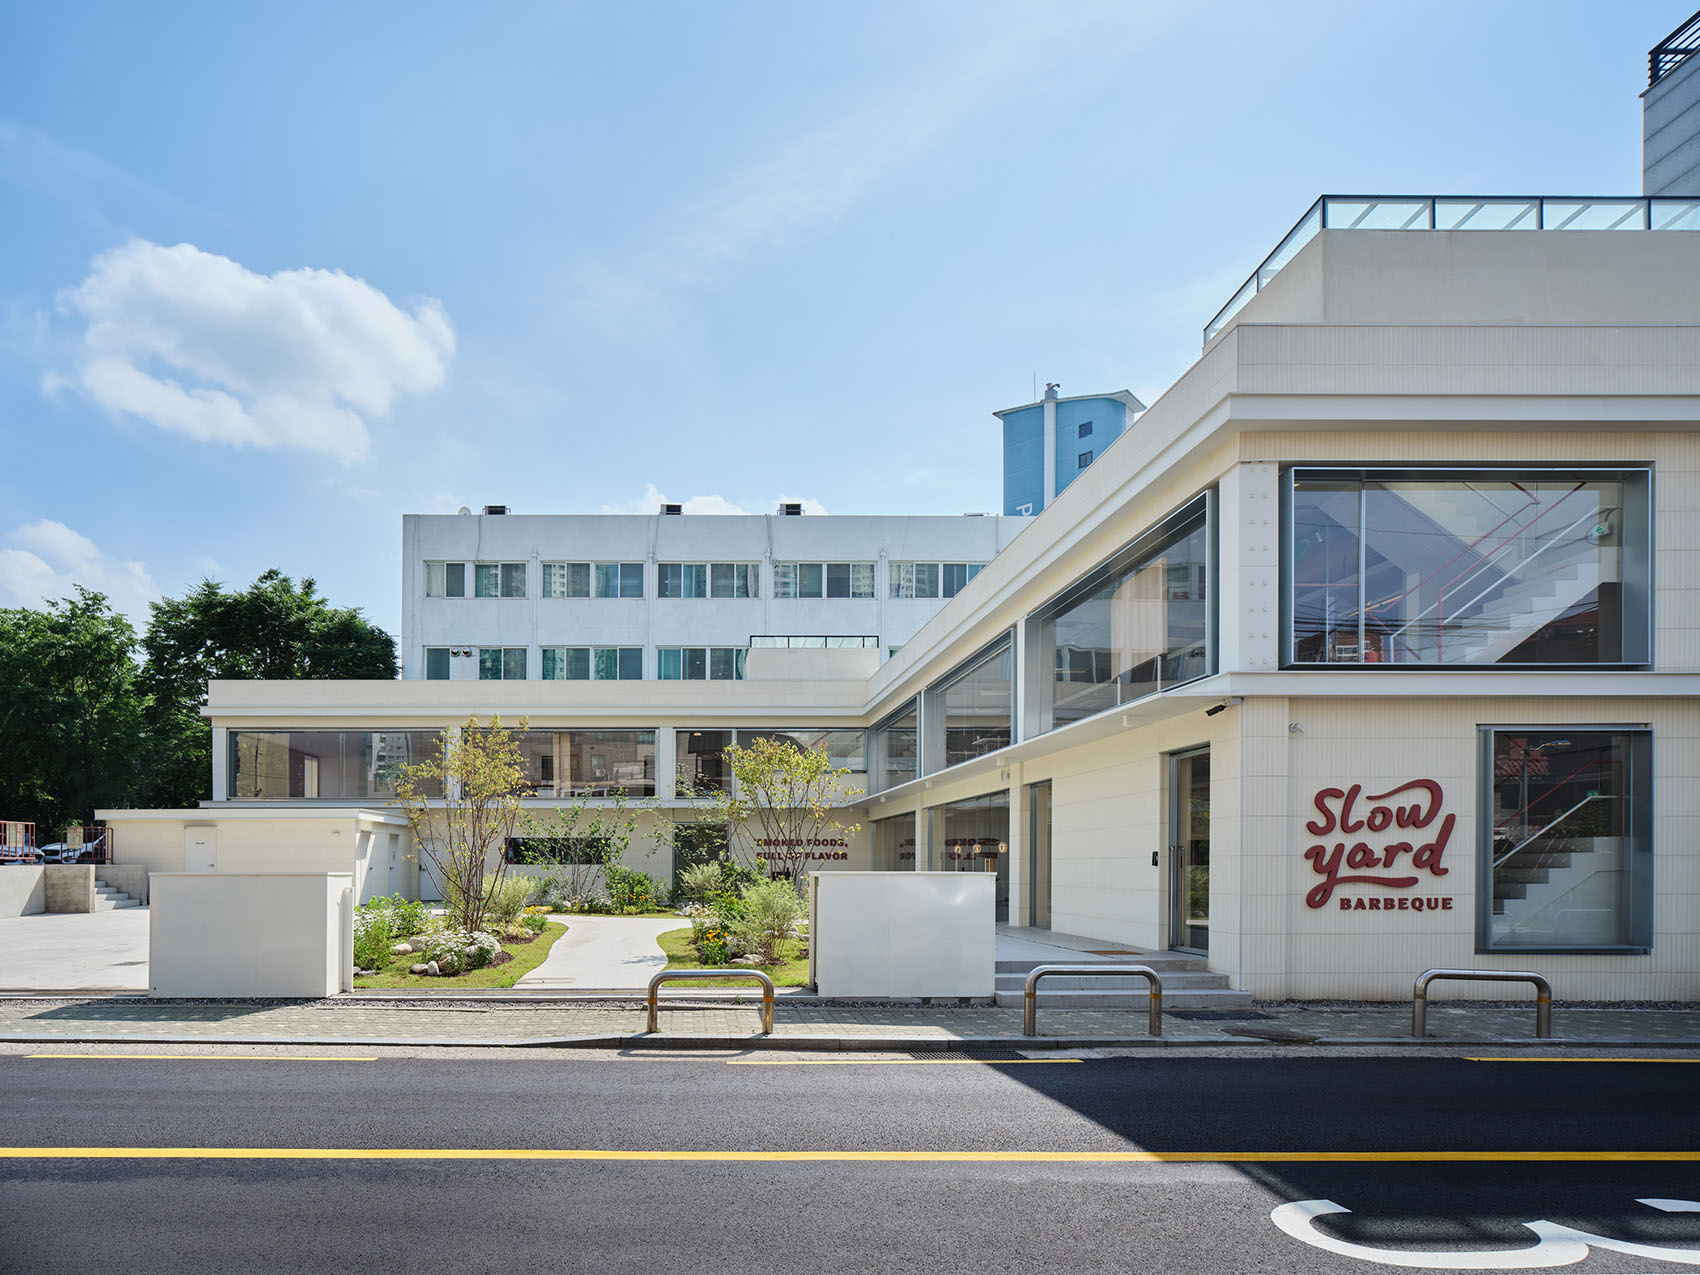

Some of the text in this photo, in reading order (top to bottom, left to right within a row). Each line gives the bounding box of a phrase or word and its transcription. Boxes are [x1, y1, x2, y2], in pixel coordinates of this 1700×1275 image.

[1306, 779, 1443, 836] Slow
[804, 852, 848, 860] FLAVOR
[1304, 813, 1456, 909] yard
[1339, 897, 1453, 912] BARBEQUE
